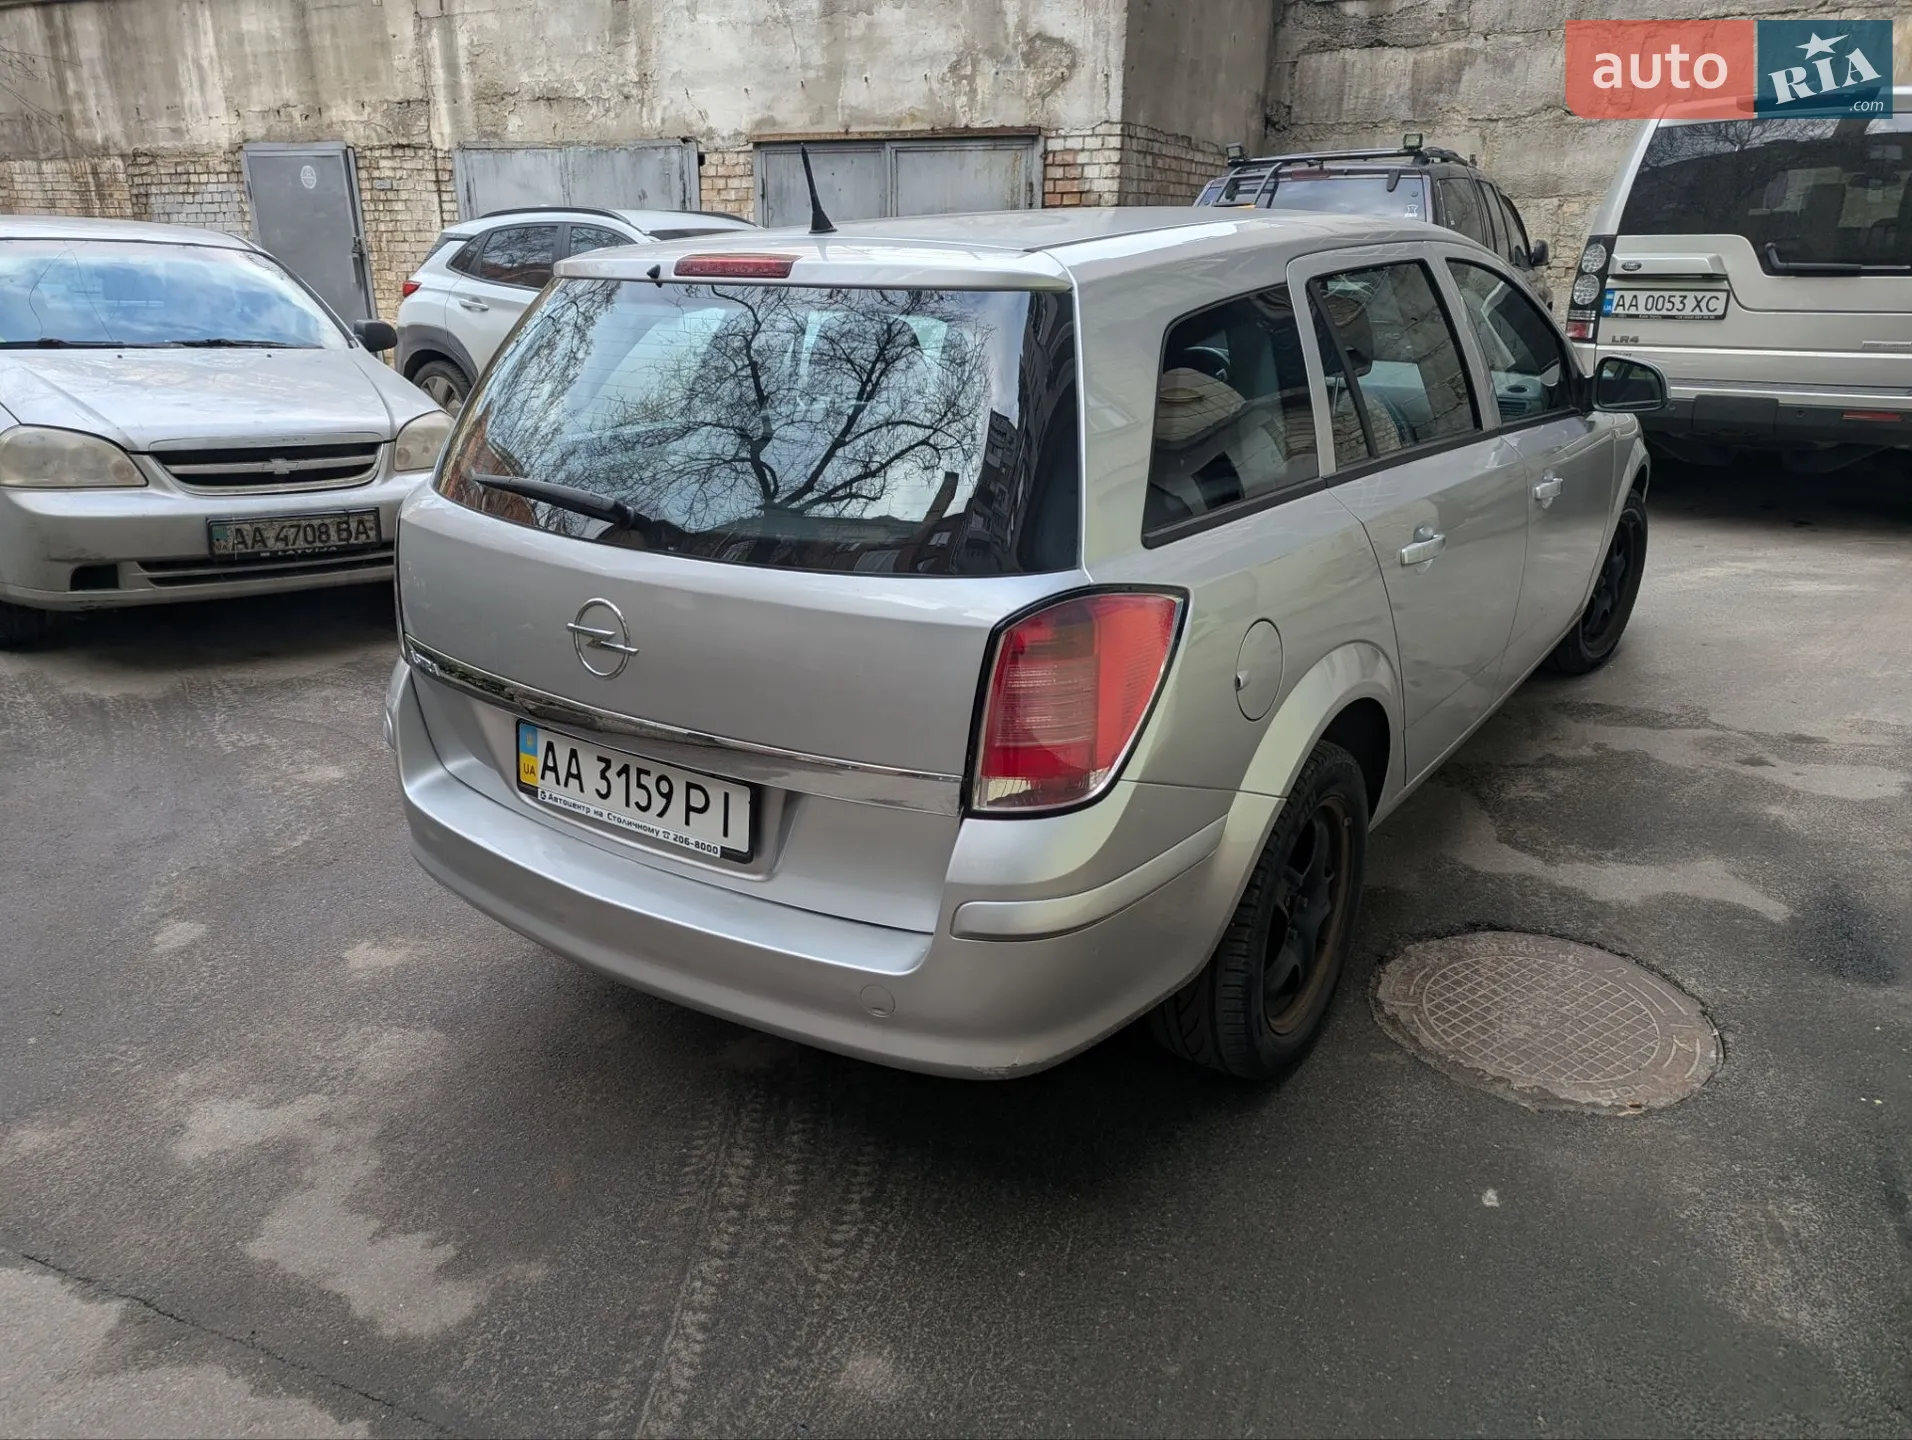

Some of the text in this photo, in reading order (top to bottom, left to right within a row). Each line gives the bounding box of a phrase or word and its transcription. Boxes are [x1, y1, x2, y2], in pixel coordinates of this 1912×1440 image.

[1614, 294, 1720, 313] AA 0053 XC
[1612, 335, 1640, 344] LR4
[232, 519, 370, 550] AA 4708 BA
[523, 762, 536, 777] UA
[540, 740, 584, 793] AA
[594, 756, 674, 818] 3159
[548, 793, 719, 855] Автоцентр на Столичному 206-8000
